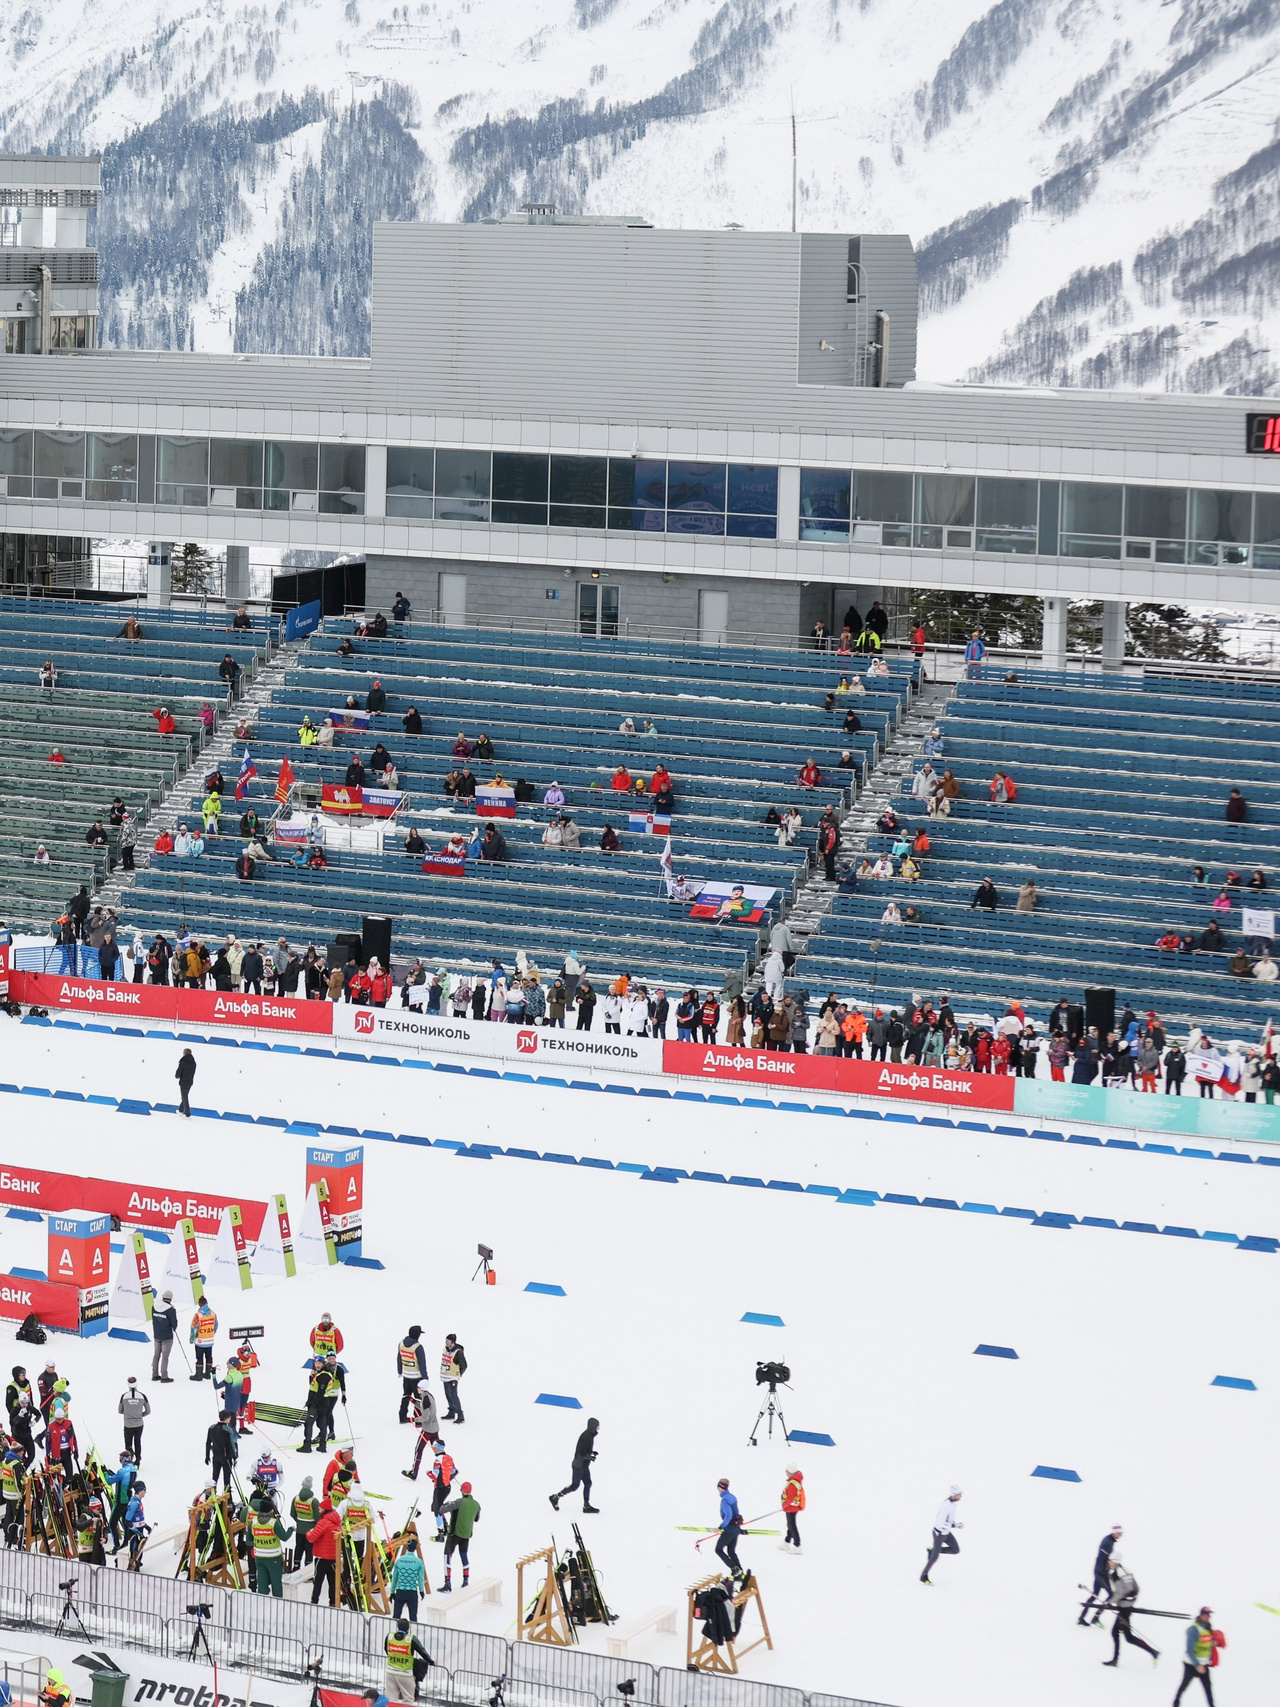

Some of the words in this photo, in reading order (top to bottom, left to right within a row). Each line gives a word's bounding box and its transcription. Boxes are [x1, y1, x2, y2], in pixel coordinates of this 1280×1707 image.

[368, 796, 396, 806] ЗЛАТОУСТ
[60, 982, 103, 1001] Альфа
[106, 987, 141, 1004] Банк
[214, 997, 259, 1017] Альфа
[261, 1002, 297, 1019] Банк
[378, 1019, 471, 1040] ТЕХНОНИКОЛЬ
[541, 1038, 638, 1058] ТЕХНОНИКОЛЬ
[703, 1050, 754, 1070] Альфа
[756, 1055, 796, 1074] Банк
[878, 1068, 930, 1090] Альфа
[932, 1074, 972, 1094] Банк
[313, 1151, 334, 1163] СТАРТ
[345, 1150, 360, 1163] СТАРТ
[0, 1172, 41, 1195] Банк
[128, 1191, 184, 1216] Альфа
[55, 1220, 77, 1233] СТАРТ
[89, 1219, 106, 1232] СТАРТ
